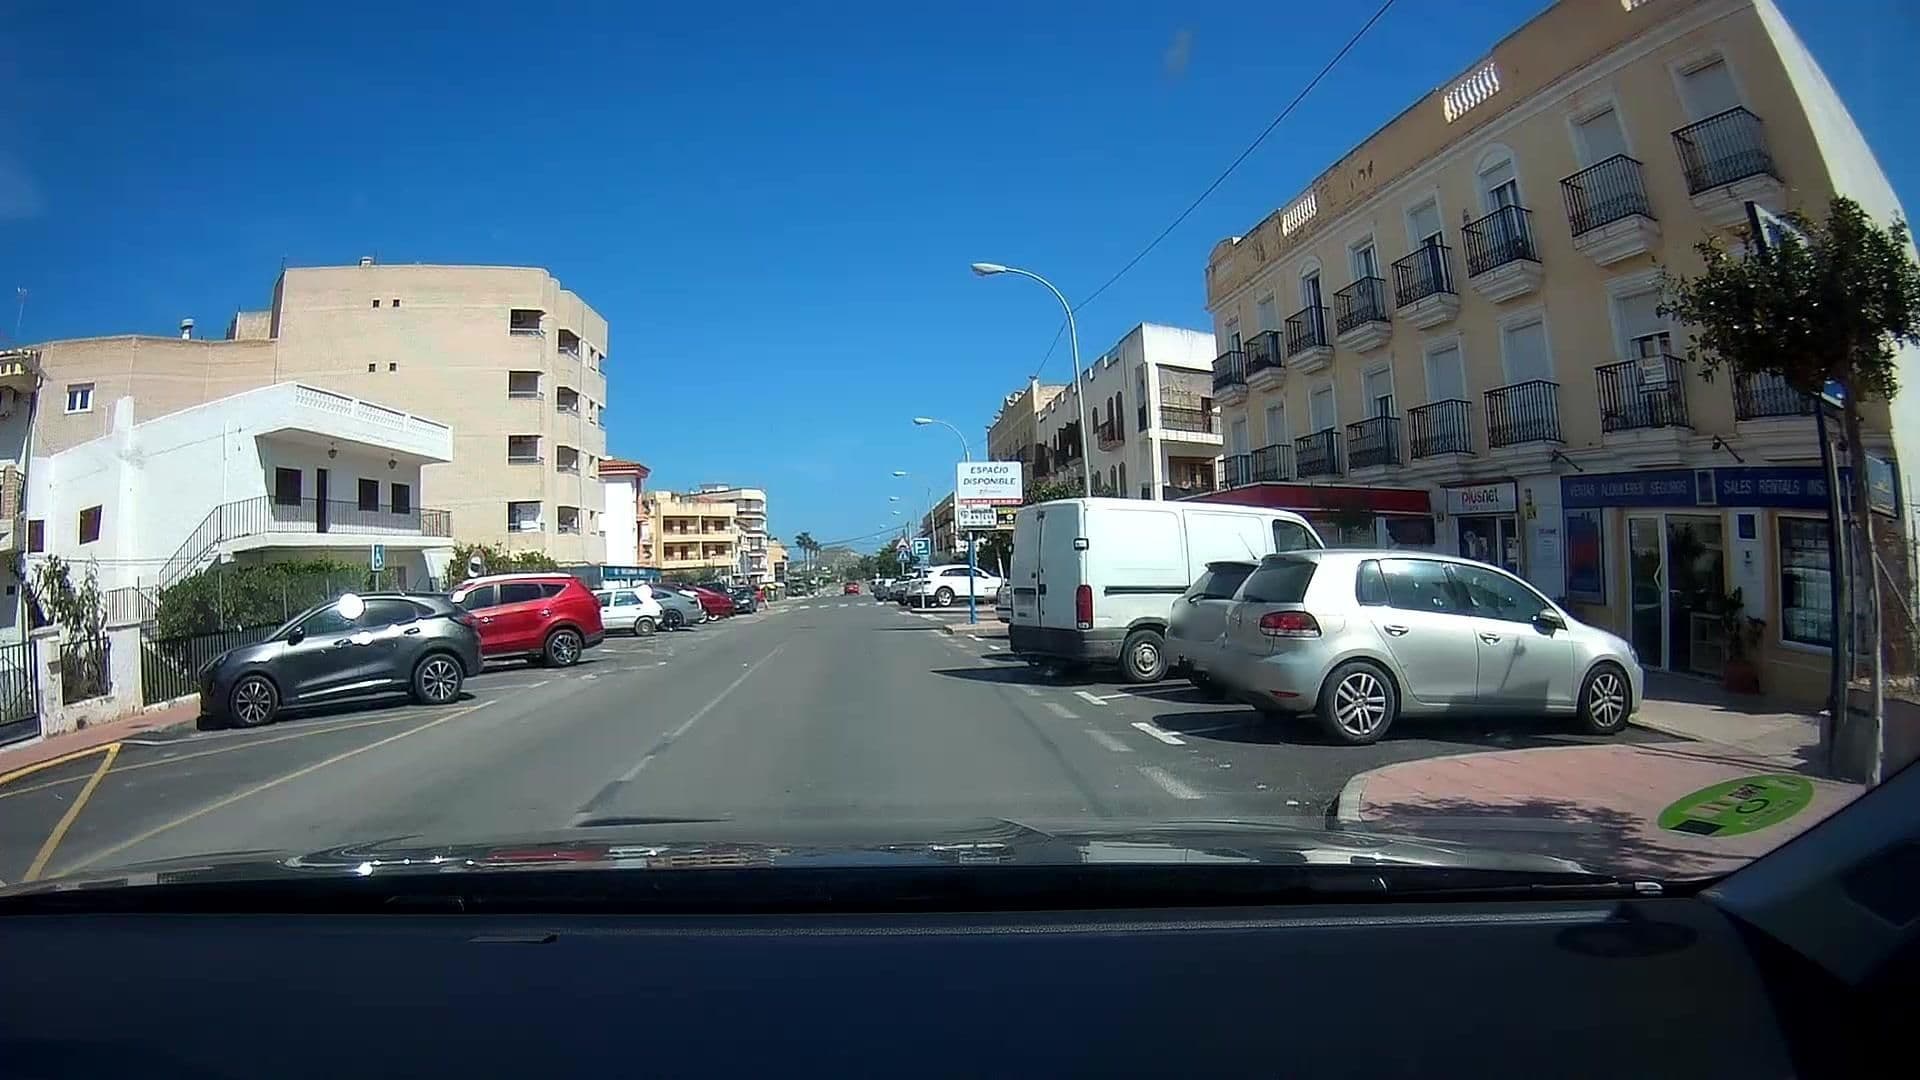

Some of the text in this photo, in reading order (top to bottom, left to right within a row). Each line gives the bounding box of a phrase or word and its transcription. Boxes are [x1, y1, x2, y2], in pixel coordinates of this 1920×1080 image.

[970, 466, 1009, 474] ESPACIO
[963, 477, 1017, 486] DISPONIBLE
[1650, 480, 1688, 495] SEGUROS
[1723, 480, 1752, 495] SALES
[1759, 480, 1801, 495] RENTALS
[1461, 487, 1499, 505] plusnet
[914, 540, 925, 554] P
